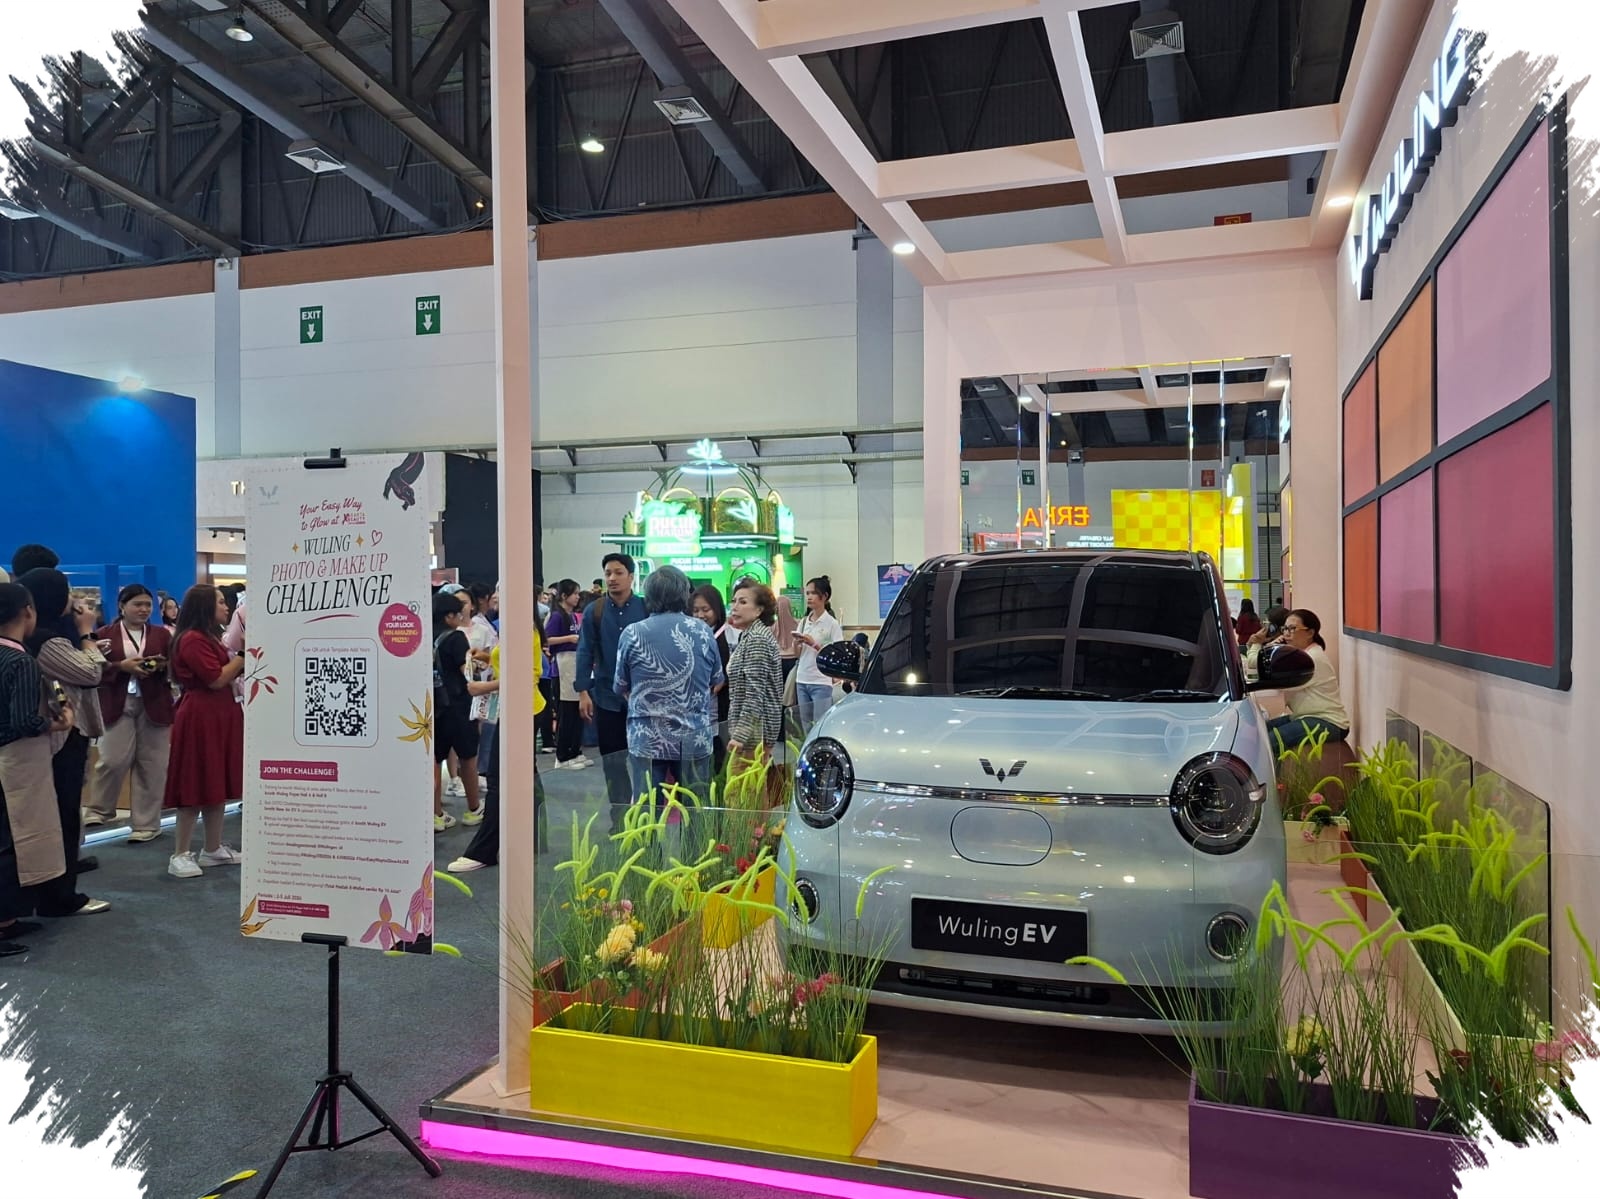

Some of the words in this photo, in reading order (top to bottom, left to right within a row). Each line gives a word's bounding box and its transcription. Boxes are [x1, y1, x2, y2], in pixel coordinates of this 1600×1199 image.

[417, 300, 439, 311] EXIT
[301, 310, 321, 321] EXIT
[299, 504, 319, 518] Your
[321, 500, 341, 513] Easy
[343, 497, 362, 511] Way
[301, 521, 308, 531] to
[310, 516, 330, 532] Glow
[331, 516, 340, 525] at
[304, 534, 352, 555] WULING
[271, 560, 315, 583] PHOTO
[317, 559, 328, 576] &
[329, 554, 368, 577] MAKE
[370, 552, 388, 571] UP
[266, 574, 393, 615] CHALLENGE
[279, 767, 293, 775] THE
[293, 768, 335, 776] CHALLENGE!
